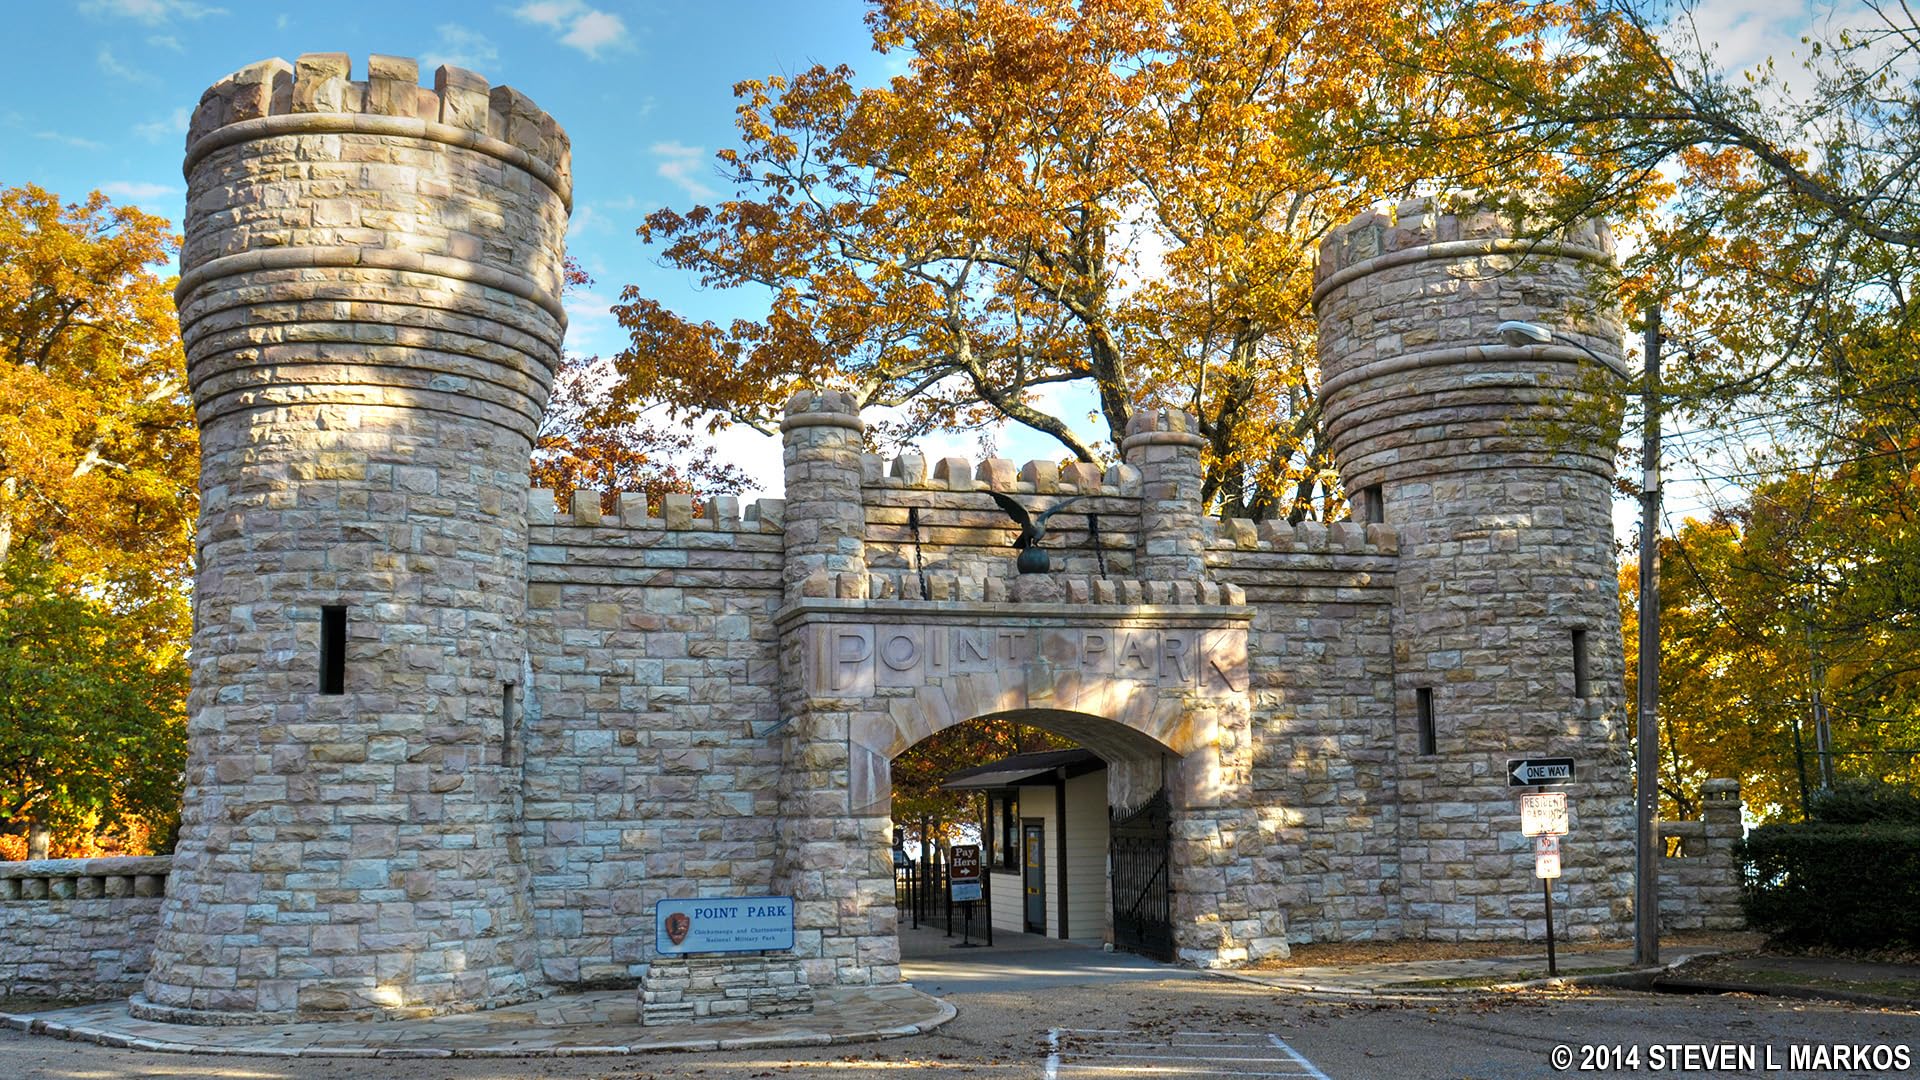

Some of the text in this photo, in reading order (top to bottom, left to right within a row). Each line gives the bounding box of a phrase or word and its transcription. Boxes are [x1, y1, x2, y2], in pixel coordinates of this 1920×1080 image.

[831, 627, 1243, 693] POINT PARK
[1526, 766, 1566, 778] ONE WAY
[1524, 797, 1563, 808] RESIDENT
[1541, 838, 1552, 847] NO
[955, 848, 974, 858] Pay
[953, 858, 977, 867] Here
[694, 905, 786, 919] POINT PARK
[734, 935, 758, 944] Military
